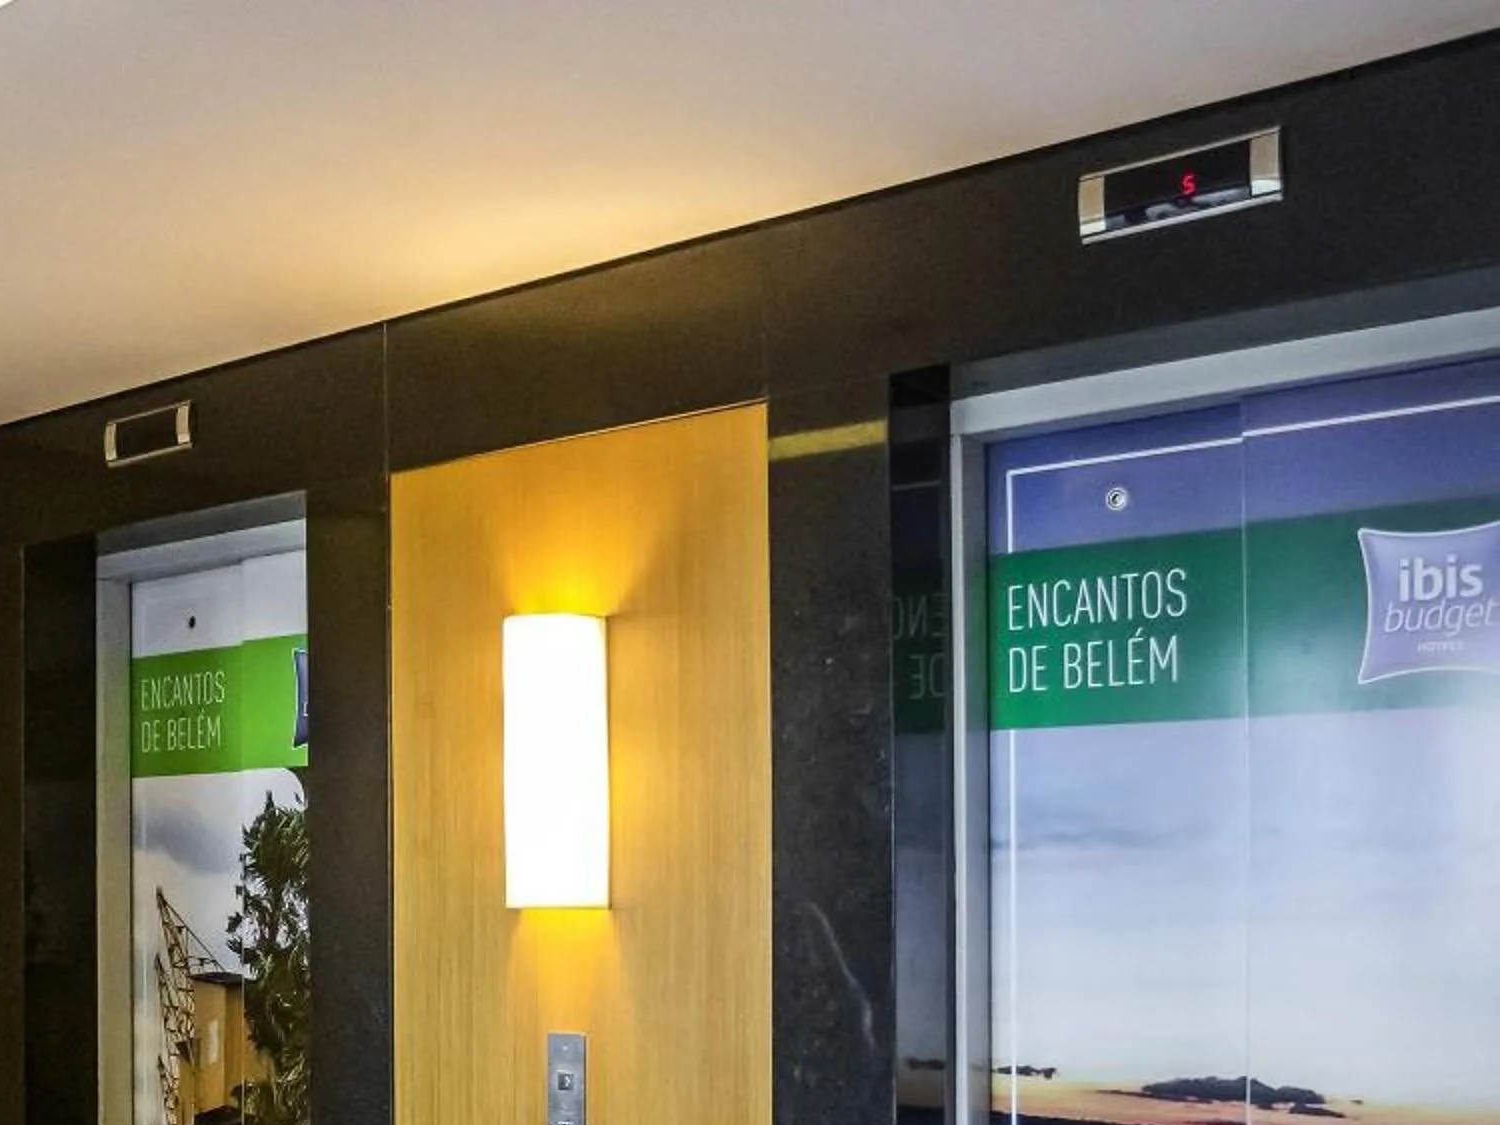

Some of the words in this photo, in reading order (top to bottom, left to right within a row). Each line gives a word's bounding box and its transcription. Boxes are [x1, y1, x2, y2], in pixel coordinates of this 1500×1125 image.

[1007, 567, 1188, 632] ENCANTOS
[1399, 553, 1484, 602] ibis
[1383, 598, 1500, 637] budget
[1009, 644, 1049, 693] DE
[1063, 626, 1178, 690] BELÉM
[140, 671, 226, 711] ENCANTOS
[141, 719, 161, 753] DE
[167, 707, 222, 751] BELÉM
